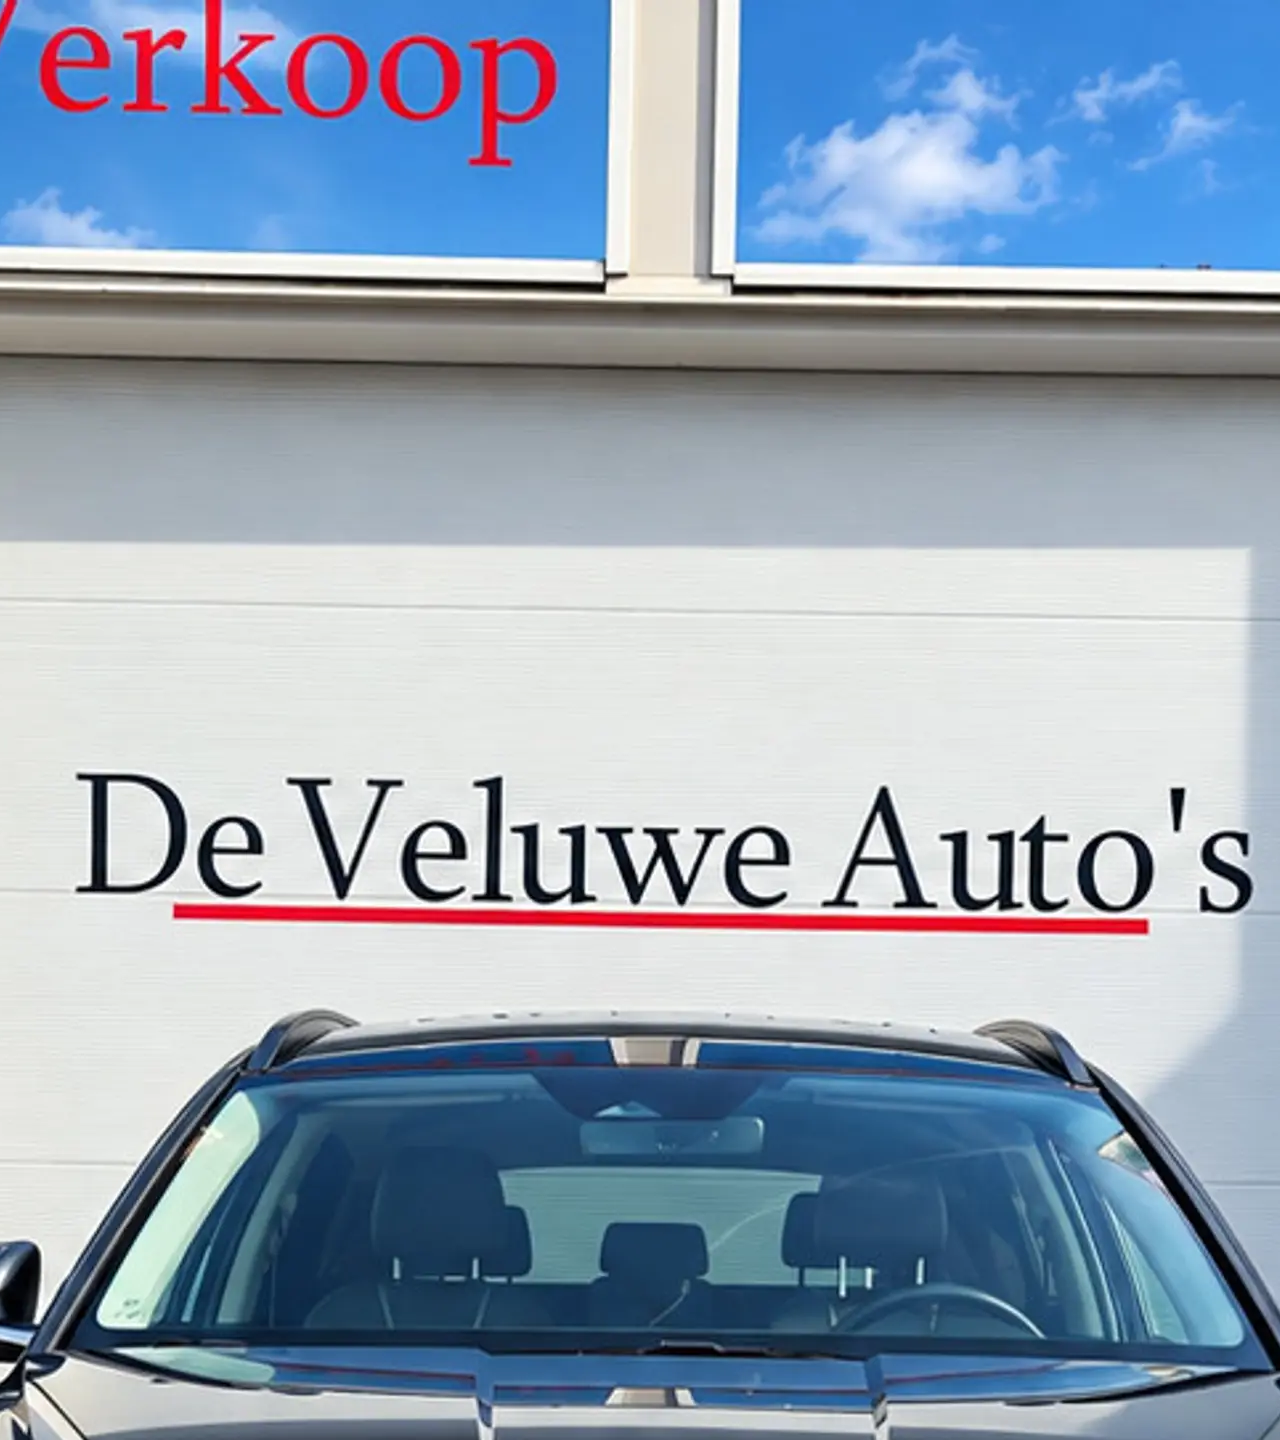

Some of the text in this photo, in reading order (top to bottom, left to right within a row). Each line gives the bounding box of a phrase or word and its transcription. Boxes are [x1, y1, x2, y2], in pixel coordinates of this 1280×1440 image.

[74, 772, 1255, 915] De Veluwe Auto's
